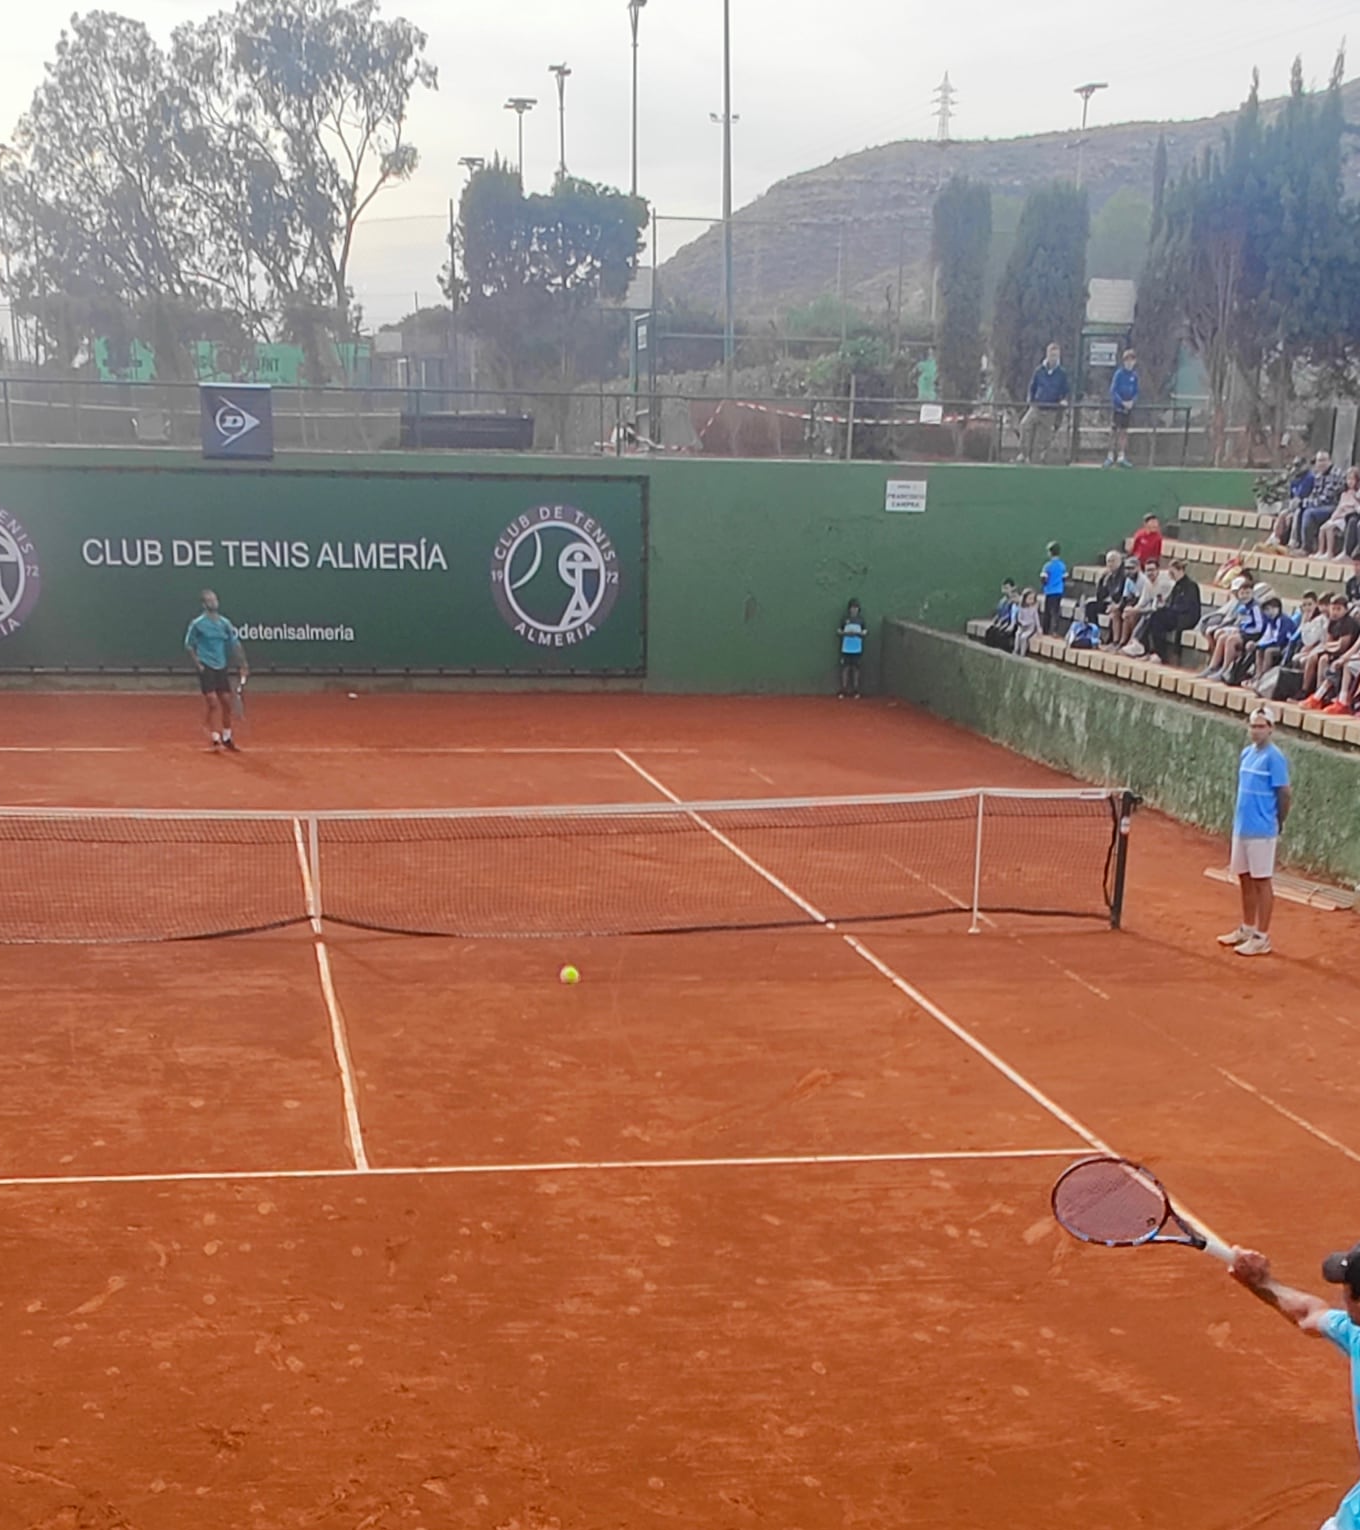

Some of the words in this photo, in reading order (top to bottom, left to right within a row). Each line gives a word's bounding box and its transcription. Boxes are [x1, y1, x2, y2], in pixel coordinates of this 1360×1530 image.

[82, 538, 163, 567] CLUB
[172, 540, 214, 567] DE
[221, 540, 310, 568] TENIS
[316, 538, 448, 570] ALMERÍA
[494, 515, 530, 560] CLUB
[539, 506, 563, 520] DE
[574, 511, 616, 561] TENIS
